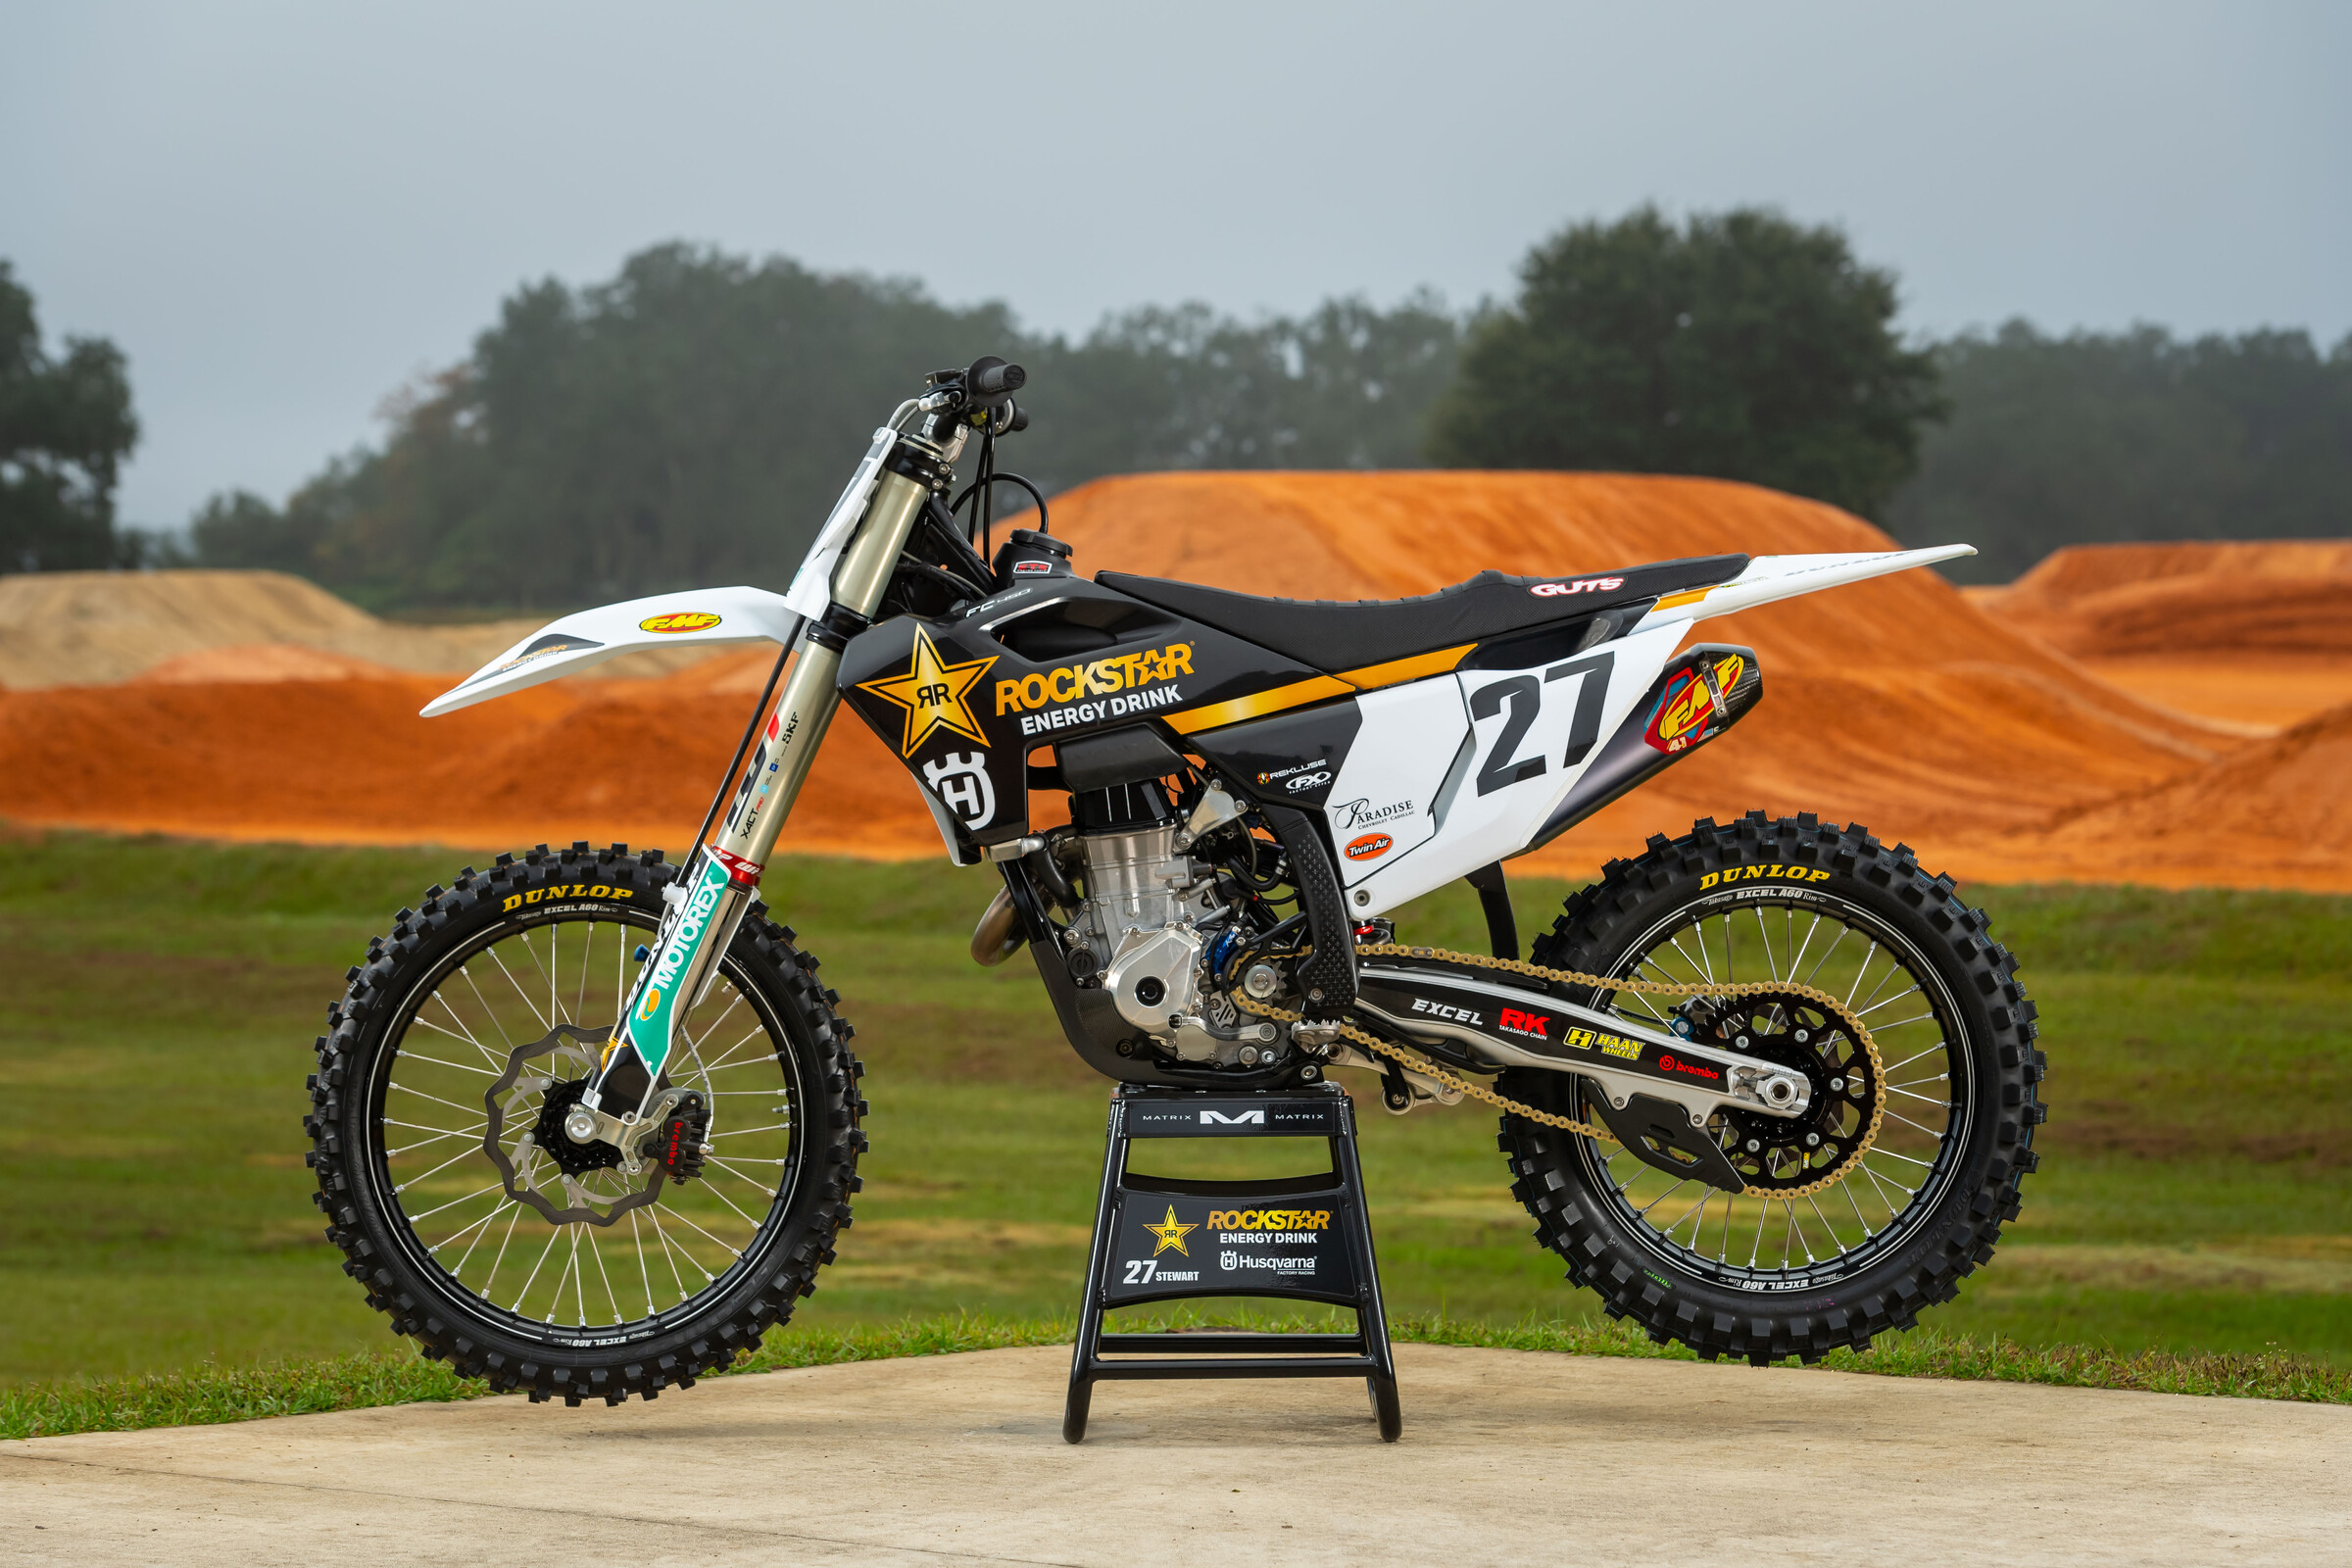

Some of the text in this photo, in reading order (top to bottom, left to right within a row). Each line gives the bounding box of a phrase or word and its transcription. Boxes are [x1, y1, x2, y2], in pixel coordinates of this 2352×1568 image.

[1530, 576, 1625, 597] GUTS
[965, 600, 996, 618] FC
[641, 613, 721, 631] FMF
[995, 643, 1195, 716] ROCKSTAR
[1020, 684, 1184, 736] ENERGY DRINK
[782, 711, 799, 745] SKF
[1470, 651, 1615, 797] 27
[1269, 759, 1327, 779] REKLUSE
[740, 807, 759, 839] XACT
[1332, 798, 1415, 829] PARADISE
[1357, 810, 1415, 830] CHEVROLET CADILLAC
[1348, 837, 1391, 858] Twin Air
[1699, 864, 1831, 891] DUNLOP
[503, 884, 634, 912] DUNLOP
[1736, 889, 1777, 900] EXCEL
[1778, 889, 1803, 898] A60
[544, 904, 577, 914] EXCEL
[655, 878, 725, 990] MOTOREX
[1411, 998, 1484, 1026] EXCEL
[1499, 1007, 1551, 1036] RK
[1498, 1025, 1547, 1041] TAKASAGO CHAIN
[1596, 1033, 1645, 1054] HAAN
[1601, 1045, 1640, 1060] WHEELS
[1676, 1060, 1719, 1080] brembo
[667, 1121, 684, 1165] brembo
[1206, 1210, 1331, 1230] ROCKSTAR
[1220, 1233, 1318, 1244] ENERGY DRINK
[1123, 1260, 1200, 1285] 27 STEWART
[1239, 1255, 1315, 1272] Husqvarna
[1728, 1277, 1742, 1287] Rim
[1742, 1280, 1765, 1291] A60
[1768, 1279, 1809, 1290] EXCEL
[594, 1336, 627, 1346] EXCEL
